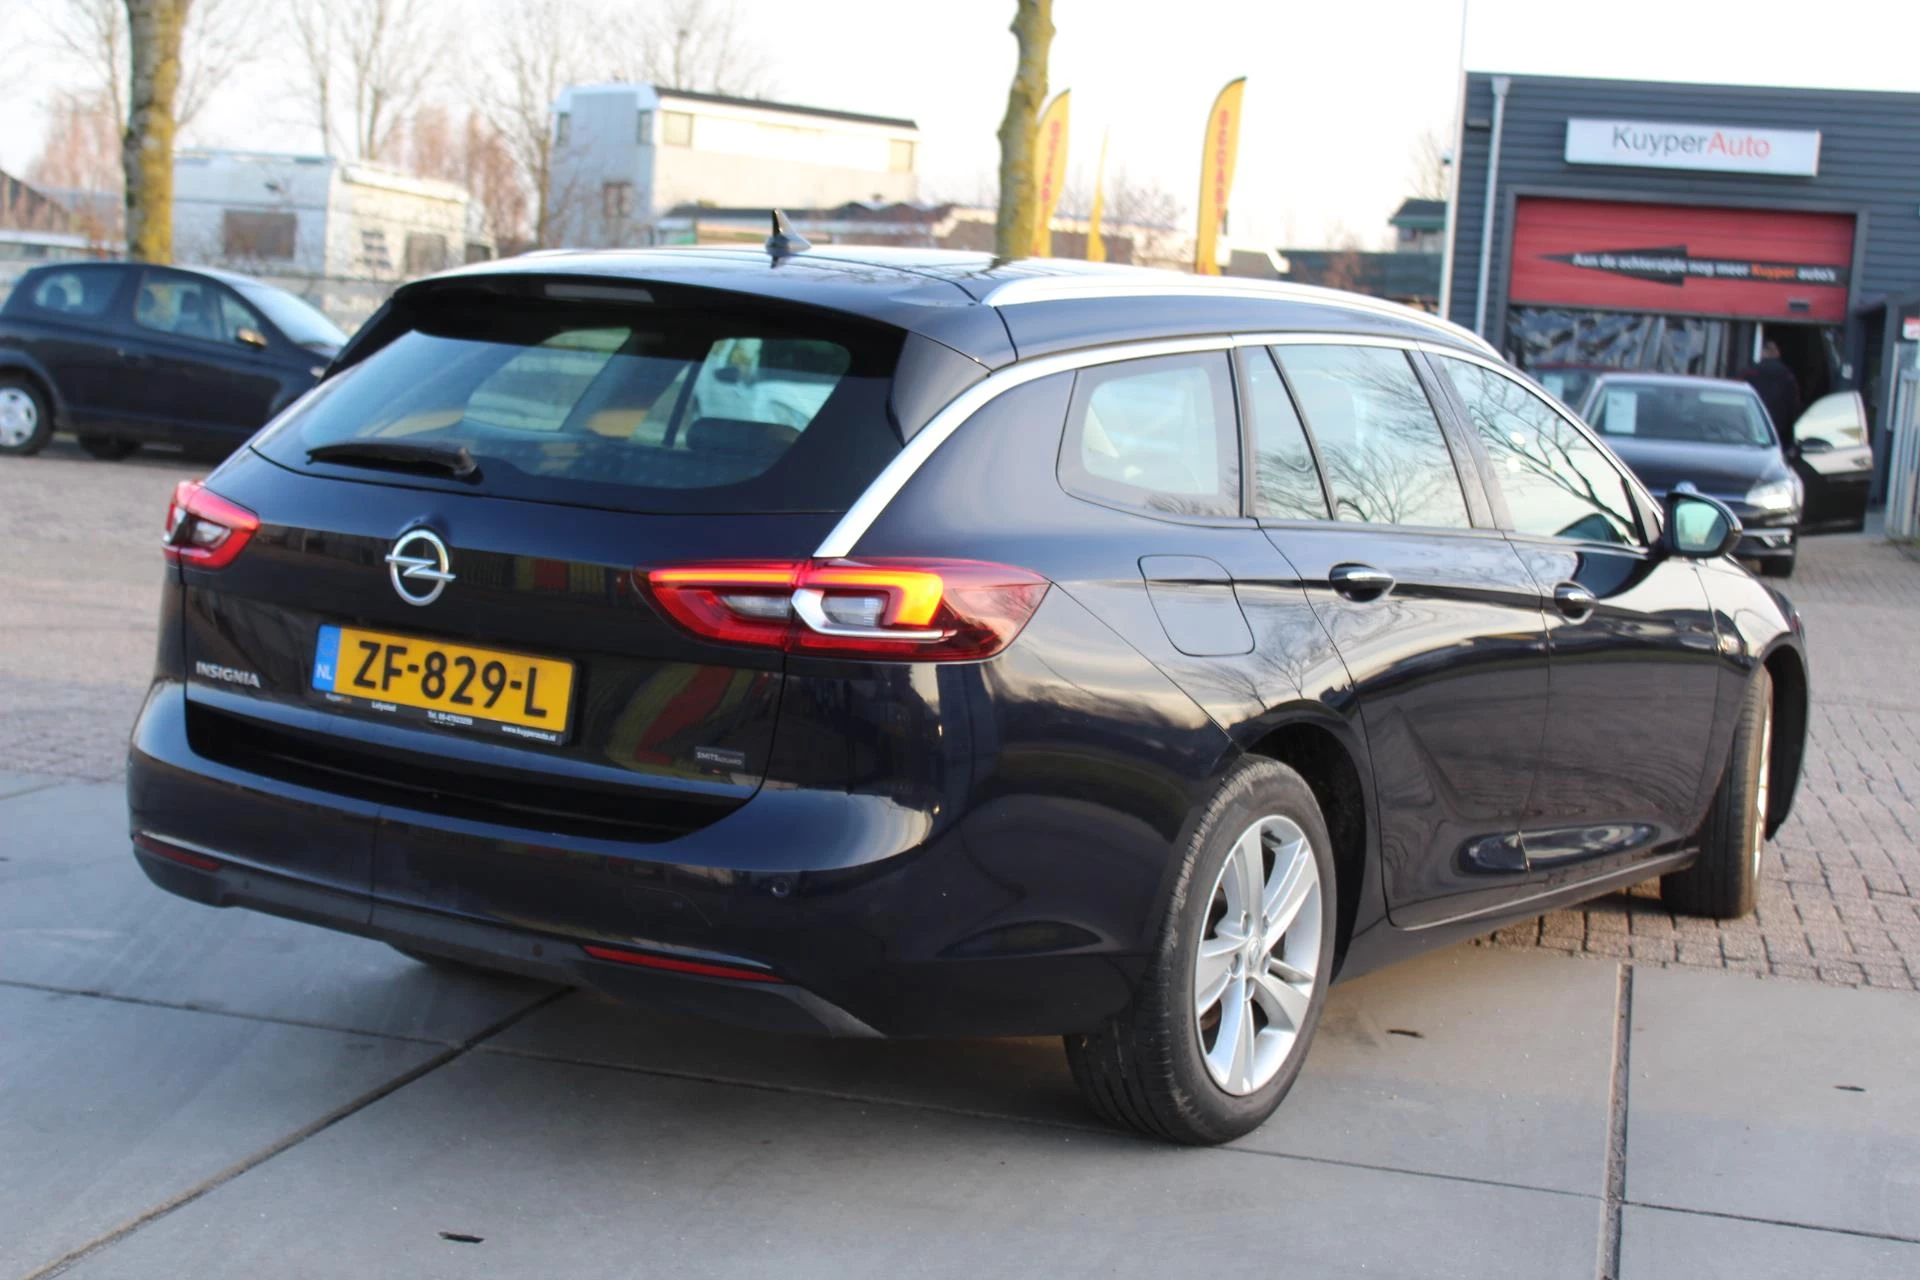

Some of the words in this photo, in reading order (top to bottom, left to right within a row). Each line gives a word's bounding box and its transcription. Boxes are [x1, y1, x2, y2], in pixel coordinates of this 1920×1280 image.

[1612, 124, 1772, 158] KuyperAuto
[1600, 254, 1616, 268] de
[196, 661, 261, 688] INSIGNIA
[316, 664, 333, 681] NL
[353, 640, 547, 718] ZF-829-L
